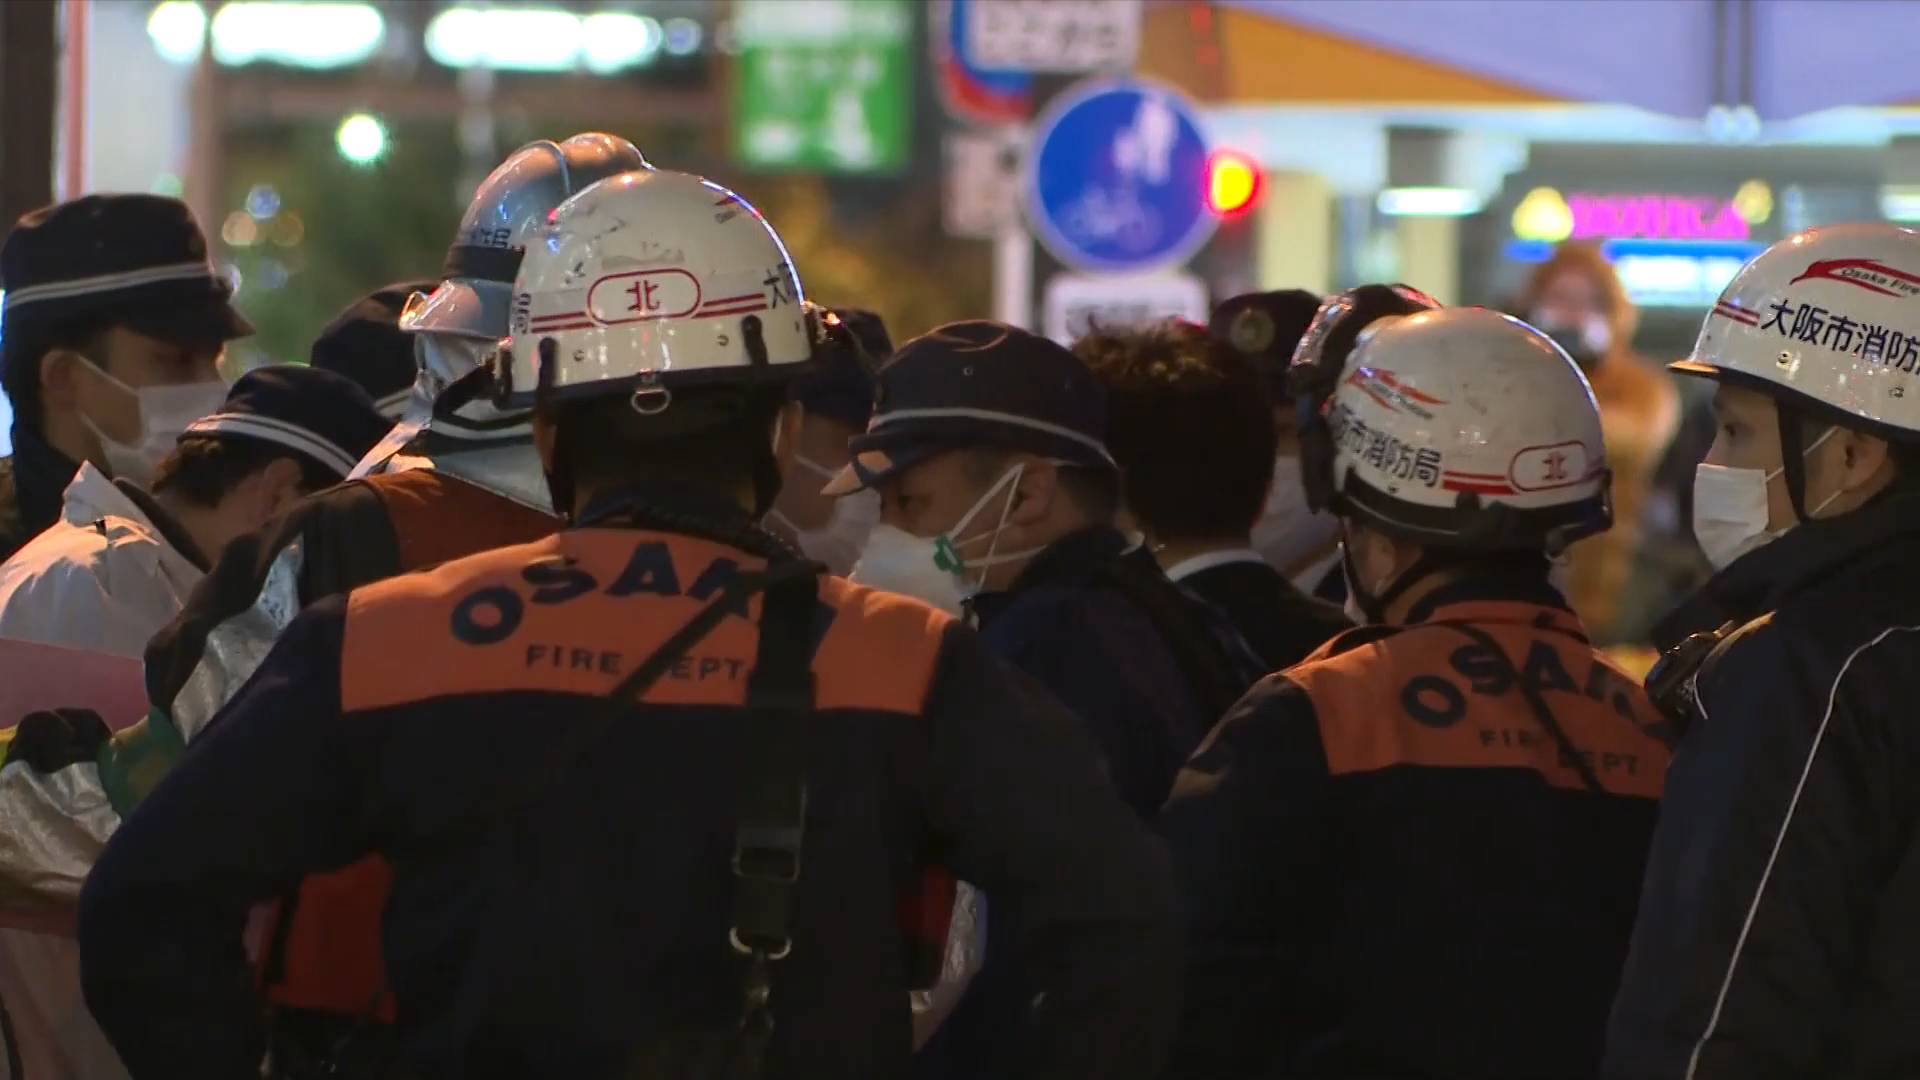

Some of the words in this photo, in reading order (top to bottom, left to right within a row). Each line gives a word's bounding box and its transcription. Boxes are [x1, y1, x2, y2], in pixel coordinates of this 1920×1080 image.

[1841, 267, 1888, 286] Osaka
[626, 279, 660, 311] 北
[1760, 299, 1920, 376] 大阪市消防
[1541, 452, 1567, 481] 北
[451, 541, 838, 665] OSAK
[526, 644, 624, 676] FIRE
[666, 654, 747, 682] EPT
[1479, 729, 1542, 750] FIR
